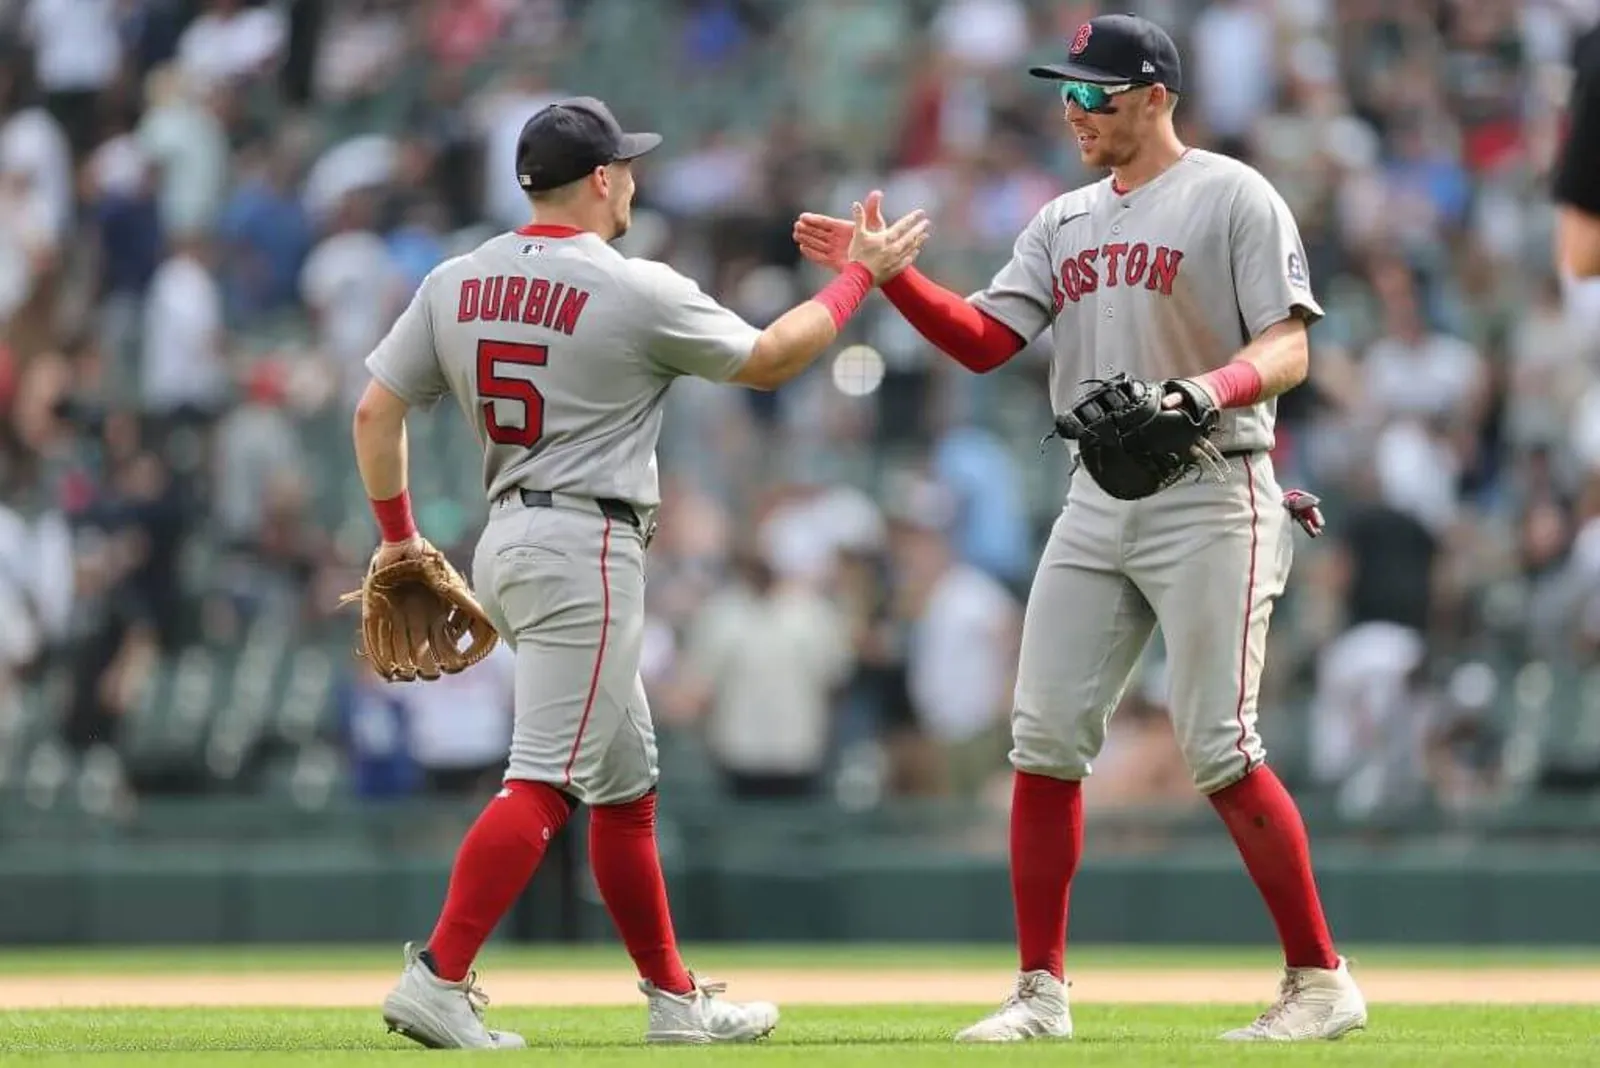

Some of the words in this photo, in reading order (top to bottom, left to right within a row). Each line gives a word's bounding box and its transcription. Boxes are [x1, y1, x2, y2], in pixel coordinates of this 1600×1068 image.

[1070, 23, 1093, 54] B
[457, 275, 590, 336] DURBIN
[476, 339, 548, 449] 5
